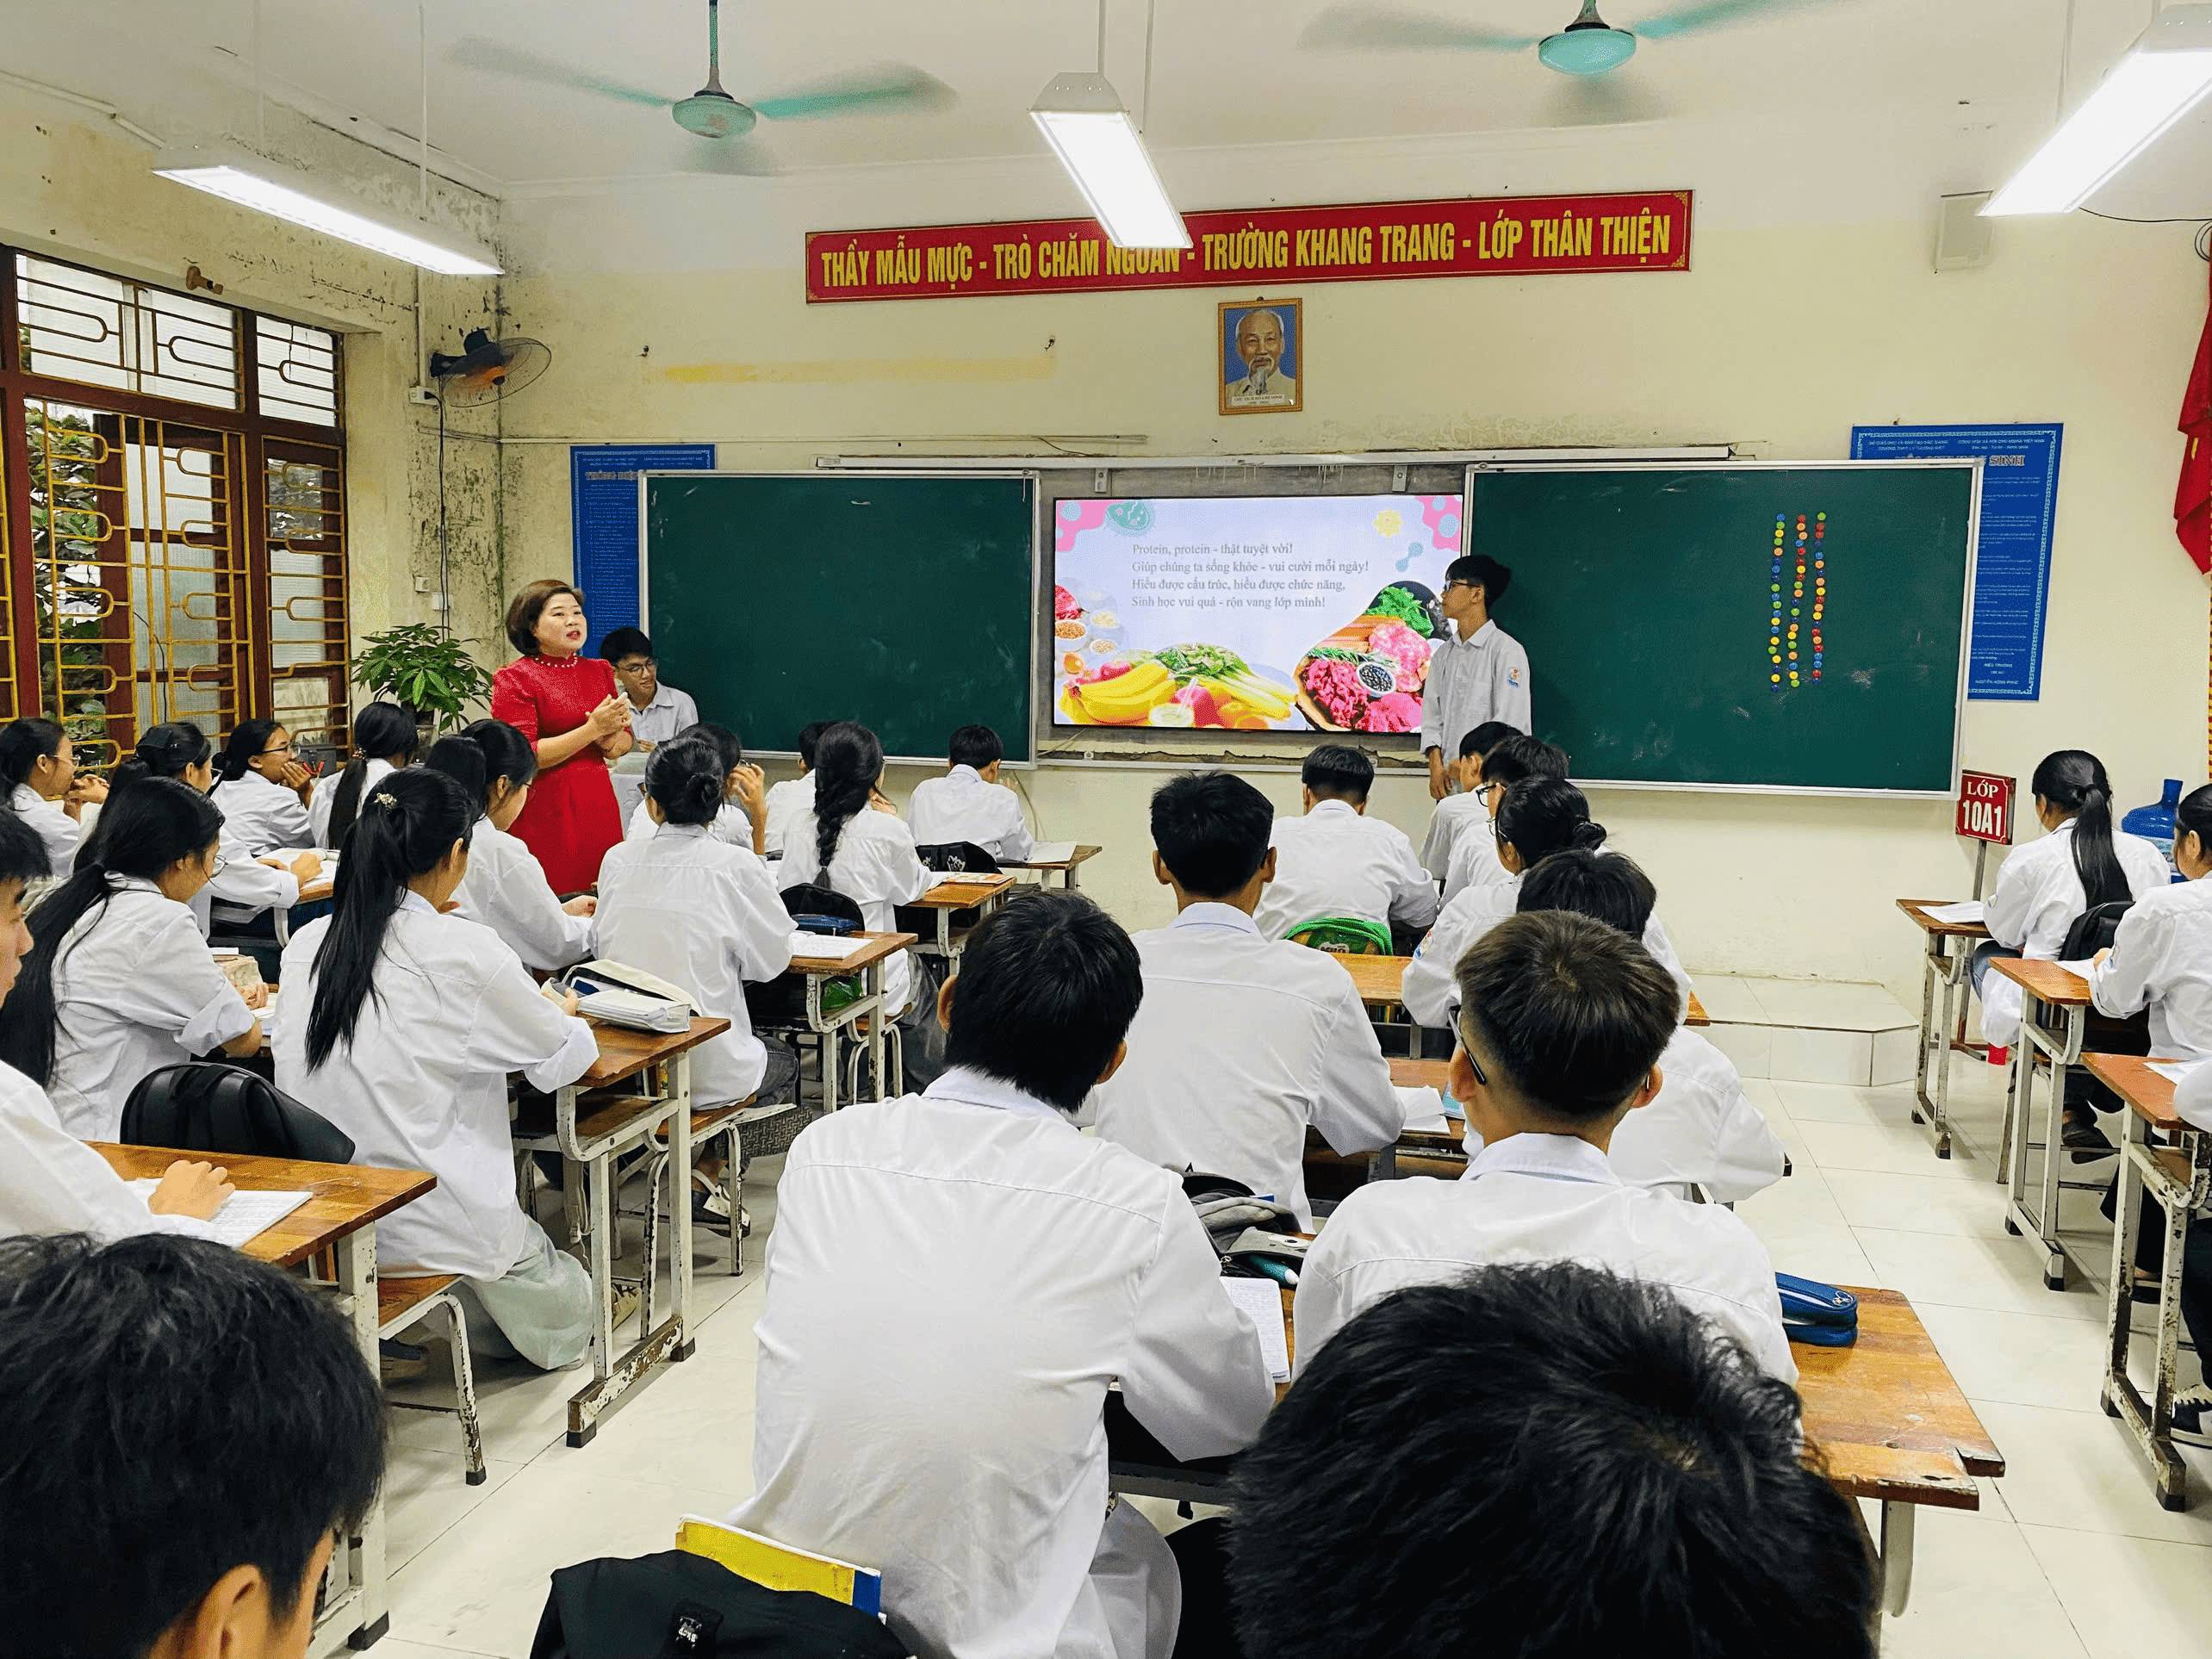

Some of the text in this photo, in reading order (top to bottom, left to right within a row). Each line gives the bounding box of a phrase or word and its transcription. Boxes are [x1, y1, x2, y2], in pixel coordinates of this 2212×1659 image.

[821, 239, 869, 287] THẦY
[875, 234, 921, 285] MẪU
[927, 242, 972, 290] MỰC
[993, 233, 1032, 280] TRÒ
[1038, 233, 1099, 278] CHĂM
[1202, 220, 1289, 270] TRƯỜNG
[1296, 227, 1372, 266] KHANG
[1379, 221, 1455, 263] TRANG
[1477, 210, 1523, 259] LỚP
[1530, 210, 1593, 258] THÂN
[1600, 207, 1670, 263] THIỆN
[1133, 544, 1171, 556] Protein,
[1174, 544, 1210, 556] protein
[1221, 544, 1240, 556] thật
[1243, 544, 1269, 556] tuyệt
[1272, 544, 1293, 554] vời!
[1132, 562, 1157, 575] Giúp
[1159, 562, 1191, 575] chúng
[1206, 558, 1229, 575] sống
[1269, 561, 1285, 571] vui
[1288, 561, 1312, 571] cười
[1315, 559, 1336, 571] mỗi
[1339, 562, 1369, 574] ngày!
[1132, 576, 1345, 592] Hiểu được cấu trúc, hiểu được chức năng,
[1131, 596, 1154, 606] Sinh
[1158, 596, 1176, 608] học
[1178, 596, 1194, 606] vui
[1246, 599, 1271, 609] vang
[1274, 596, 1292, 609] lớp
[1295, 596, 1326, 606] mình!
[1967, 779, 1998, 798] LỚP
[1963, 799, 2003, 837] 10A1
